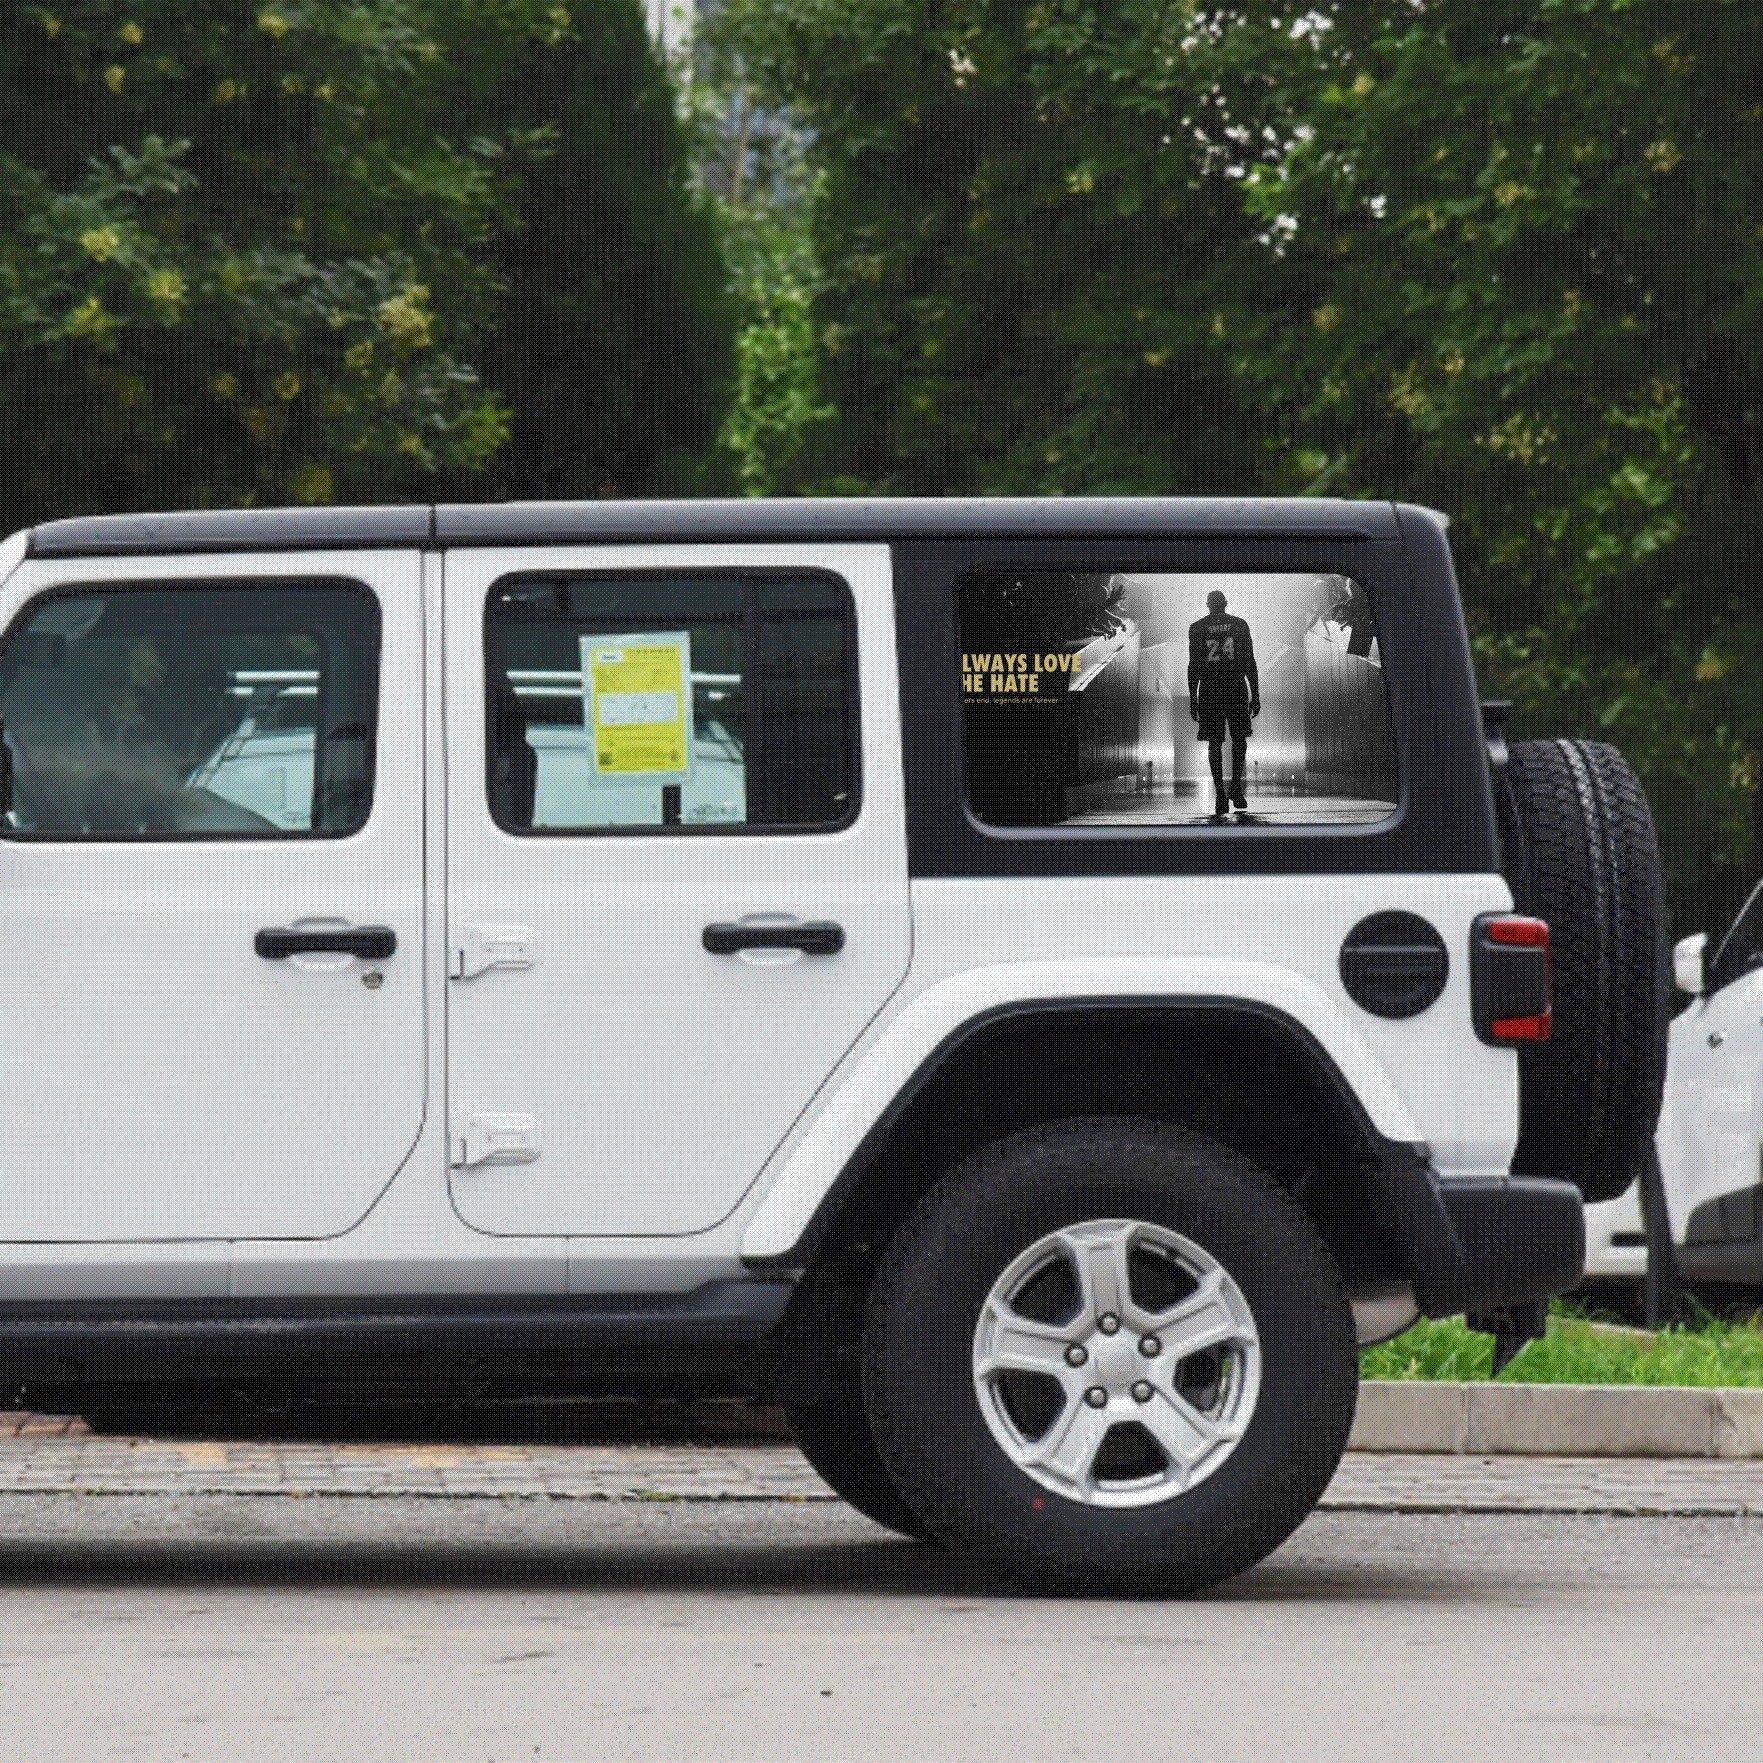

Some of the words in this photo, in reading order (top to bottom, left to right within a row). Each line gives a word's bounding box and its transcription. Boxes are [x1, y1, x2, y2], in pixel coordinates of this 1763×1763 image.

[1206, 637, 1235, 661] 24
[962, 653, 1028, 673] LWAYS
[1034, 653, 1082, 673] LOVE
[990, 673, 1039, 693] HATE
[993, 696, 1020, 706] legends
[1034, 696, 1059, 704] forever
